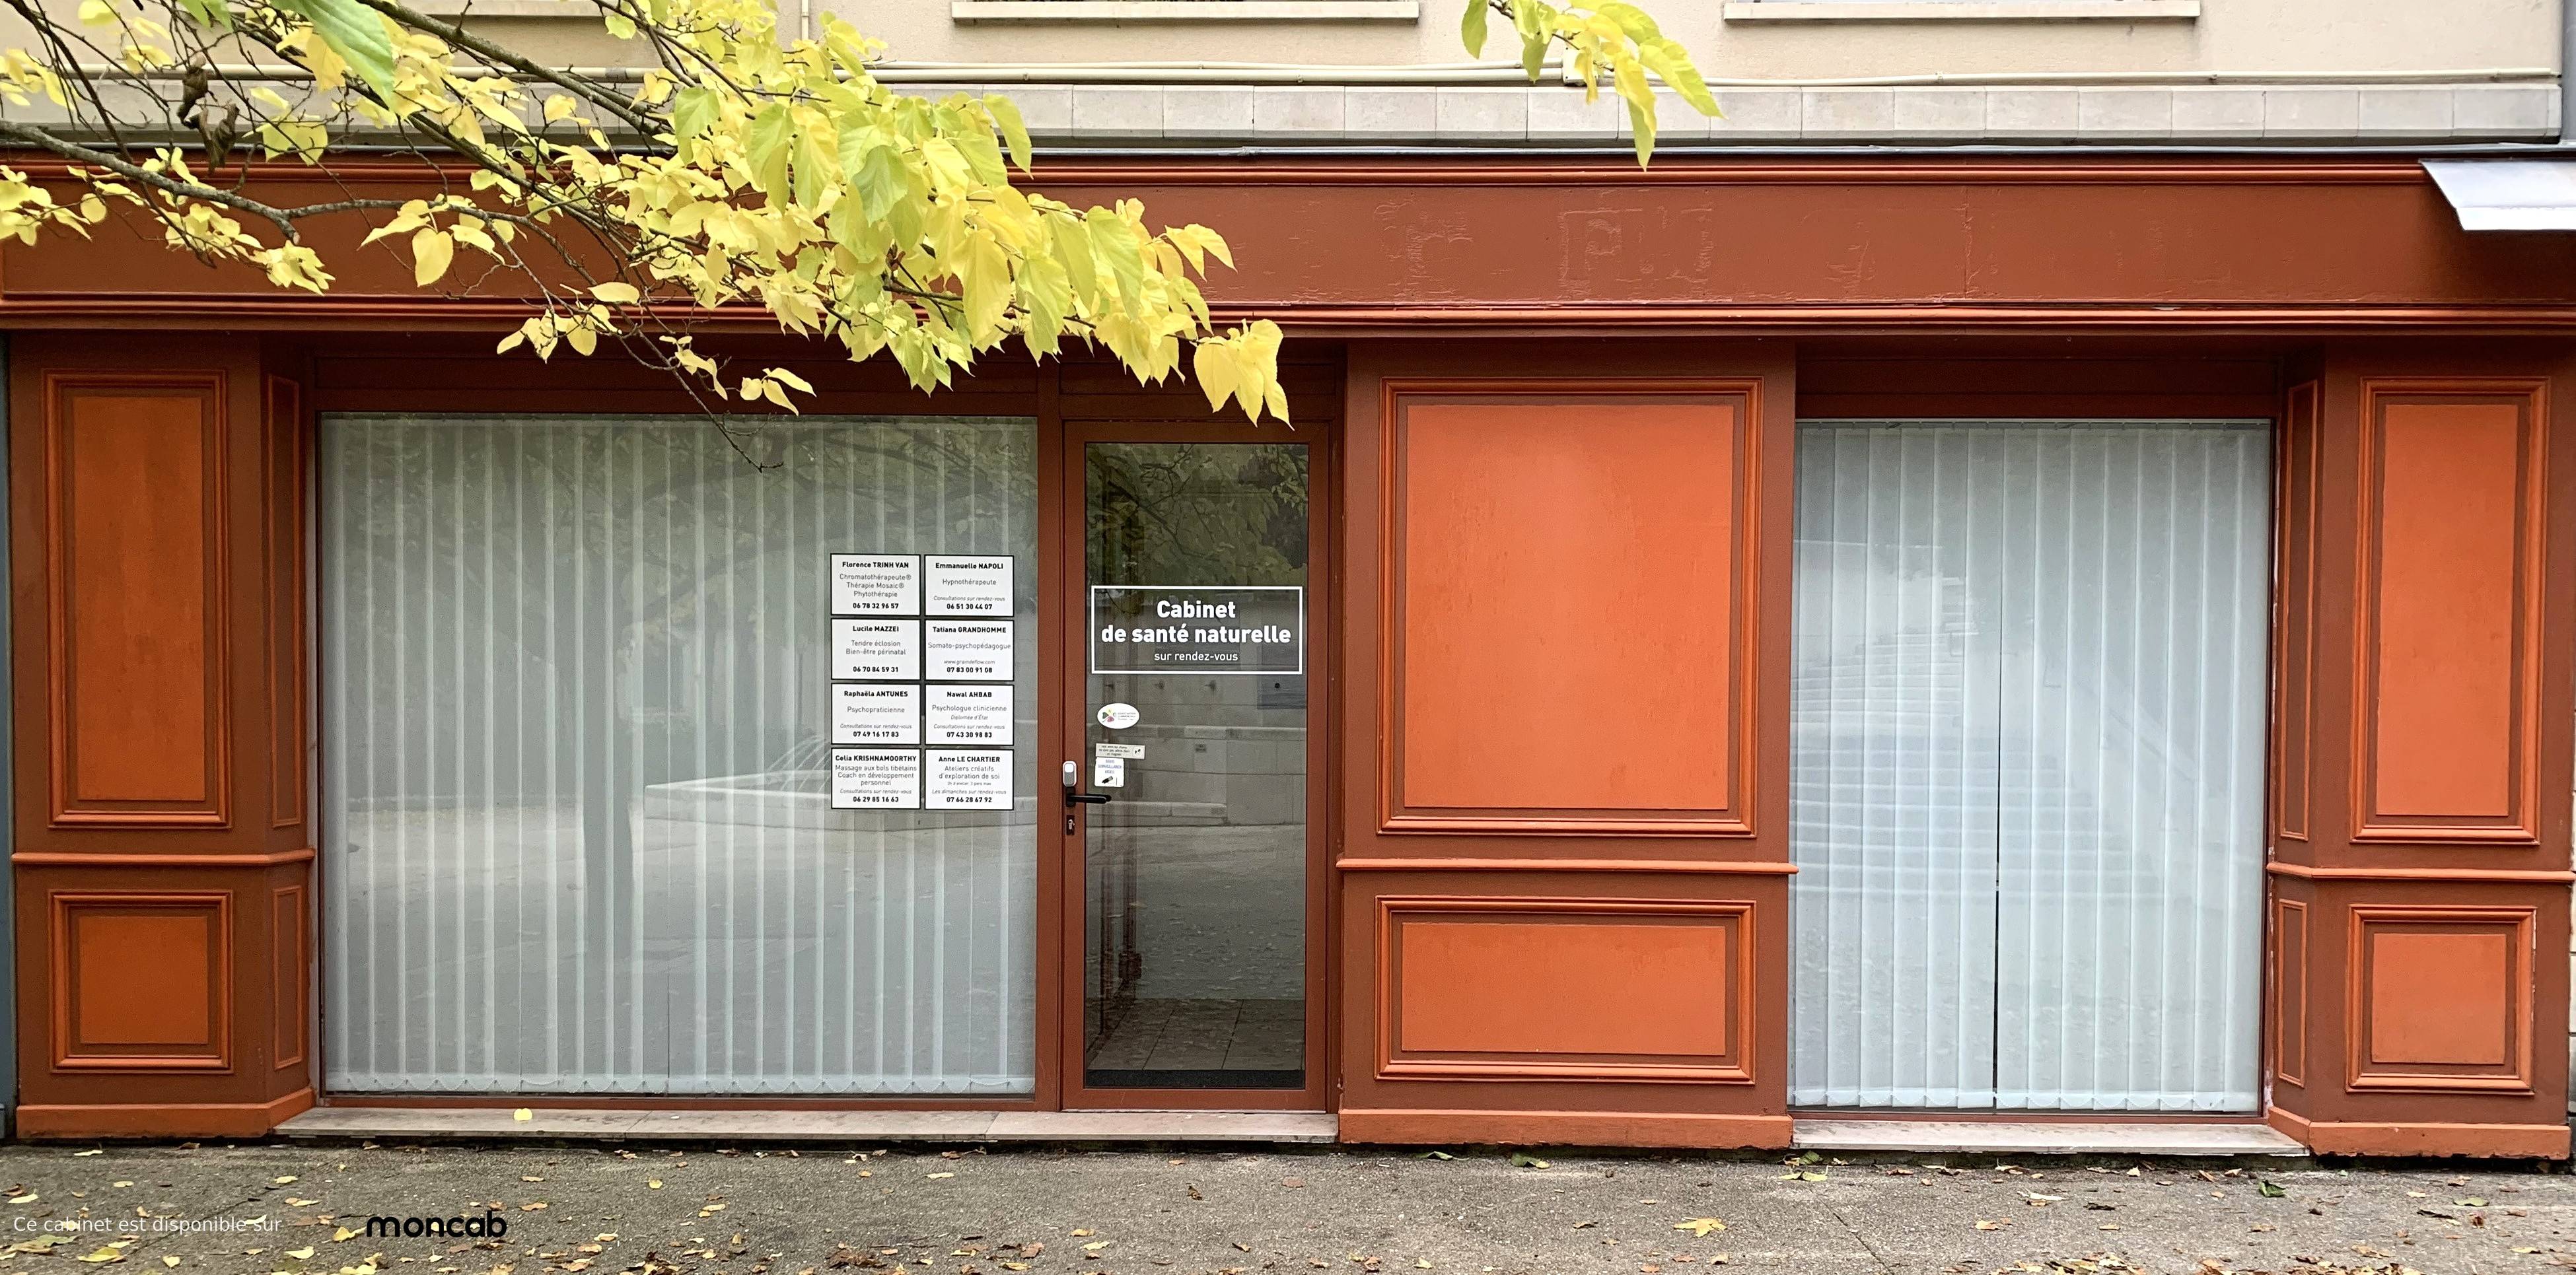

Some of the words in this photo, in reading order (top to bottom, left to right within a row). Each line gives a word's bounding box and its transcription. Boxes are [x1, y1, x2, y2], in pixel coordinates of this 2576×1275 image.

[841, 560, 872, 569] Florence
[935, 561, 978, 570] Emmanuelle
[845, 581, 875, 590] Thérapie
[942, 578, 997, 586] Hypnothérapeute
[853, 590, 898, 599] Phytothérapie
[1157, 600, 1236, 618] Cabinet
[1101, 625, 1127, 643] de
[1131, 623, 1189, 643] santé
[1195, 625, 1291, 643] naturelle
[927, 642, 1011, 651] Somato-psychopédagogue
[1174, 651, 1238, 661] rendez-vous
[847, 706, 905, 714] Psychopraticienne
[932, 704, 972, 713] Psychologue
[939, 772, 980, 780] d'exploration
